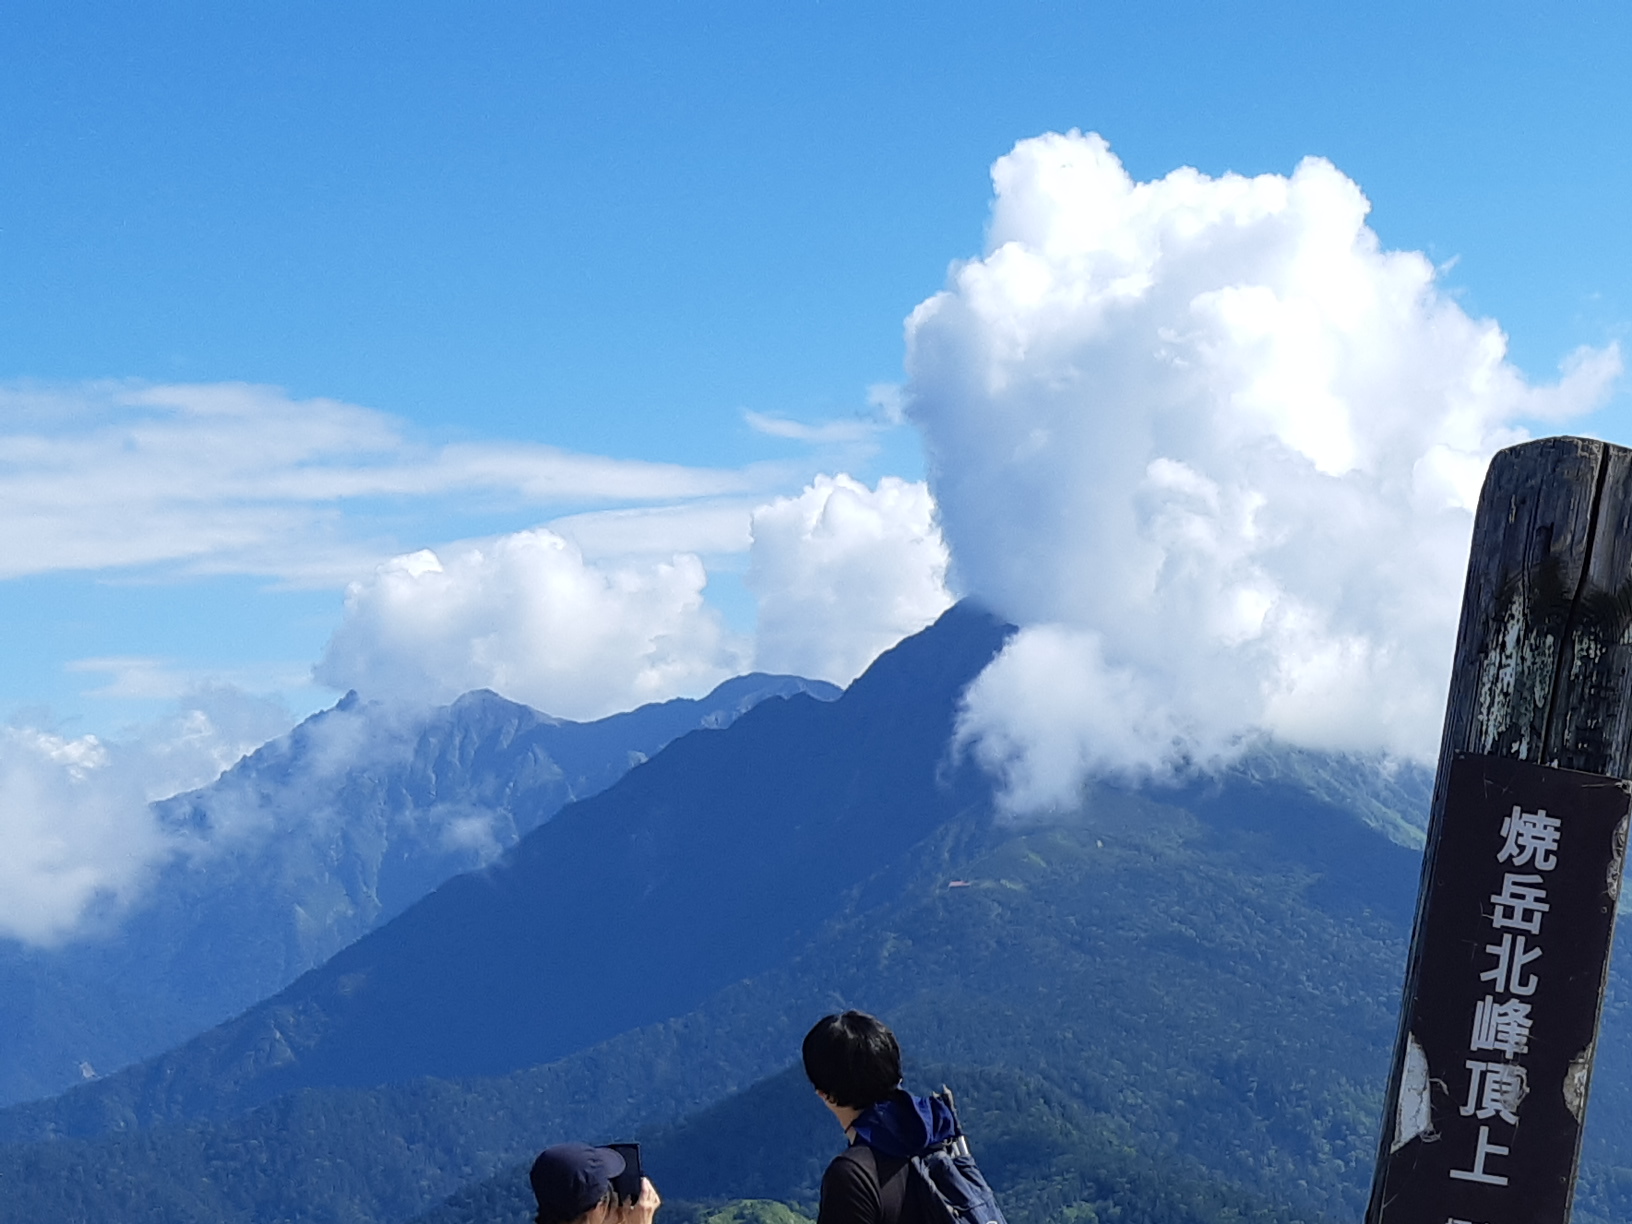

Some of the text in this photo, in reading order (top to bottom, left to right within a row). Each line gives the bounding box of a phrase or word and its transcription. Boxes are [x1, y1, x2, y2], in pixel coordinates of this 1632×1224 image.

[1449, 805, 1562, 1187] 焼岳北峰頂上
